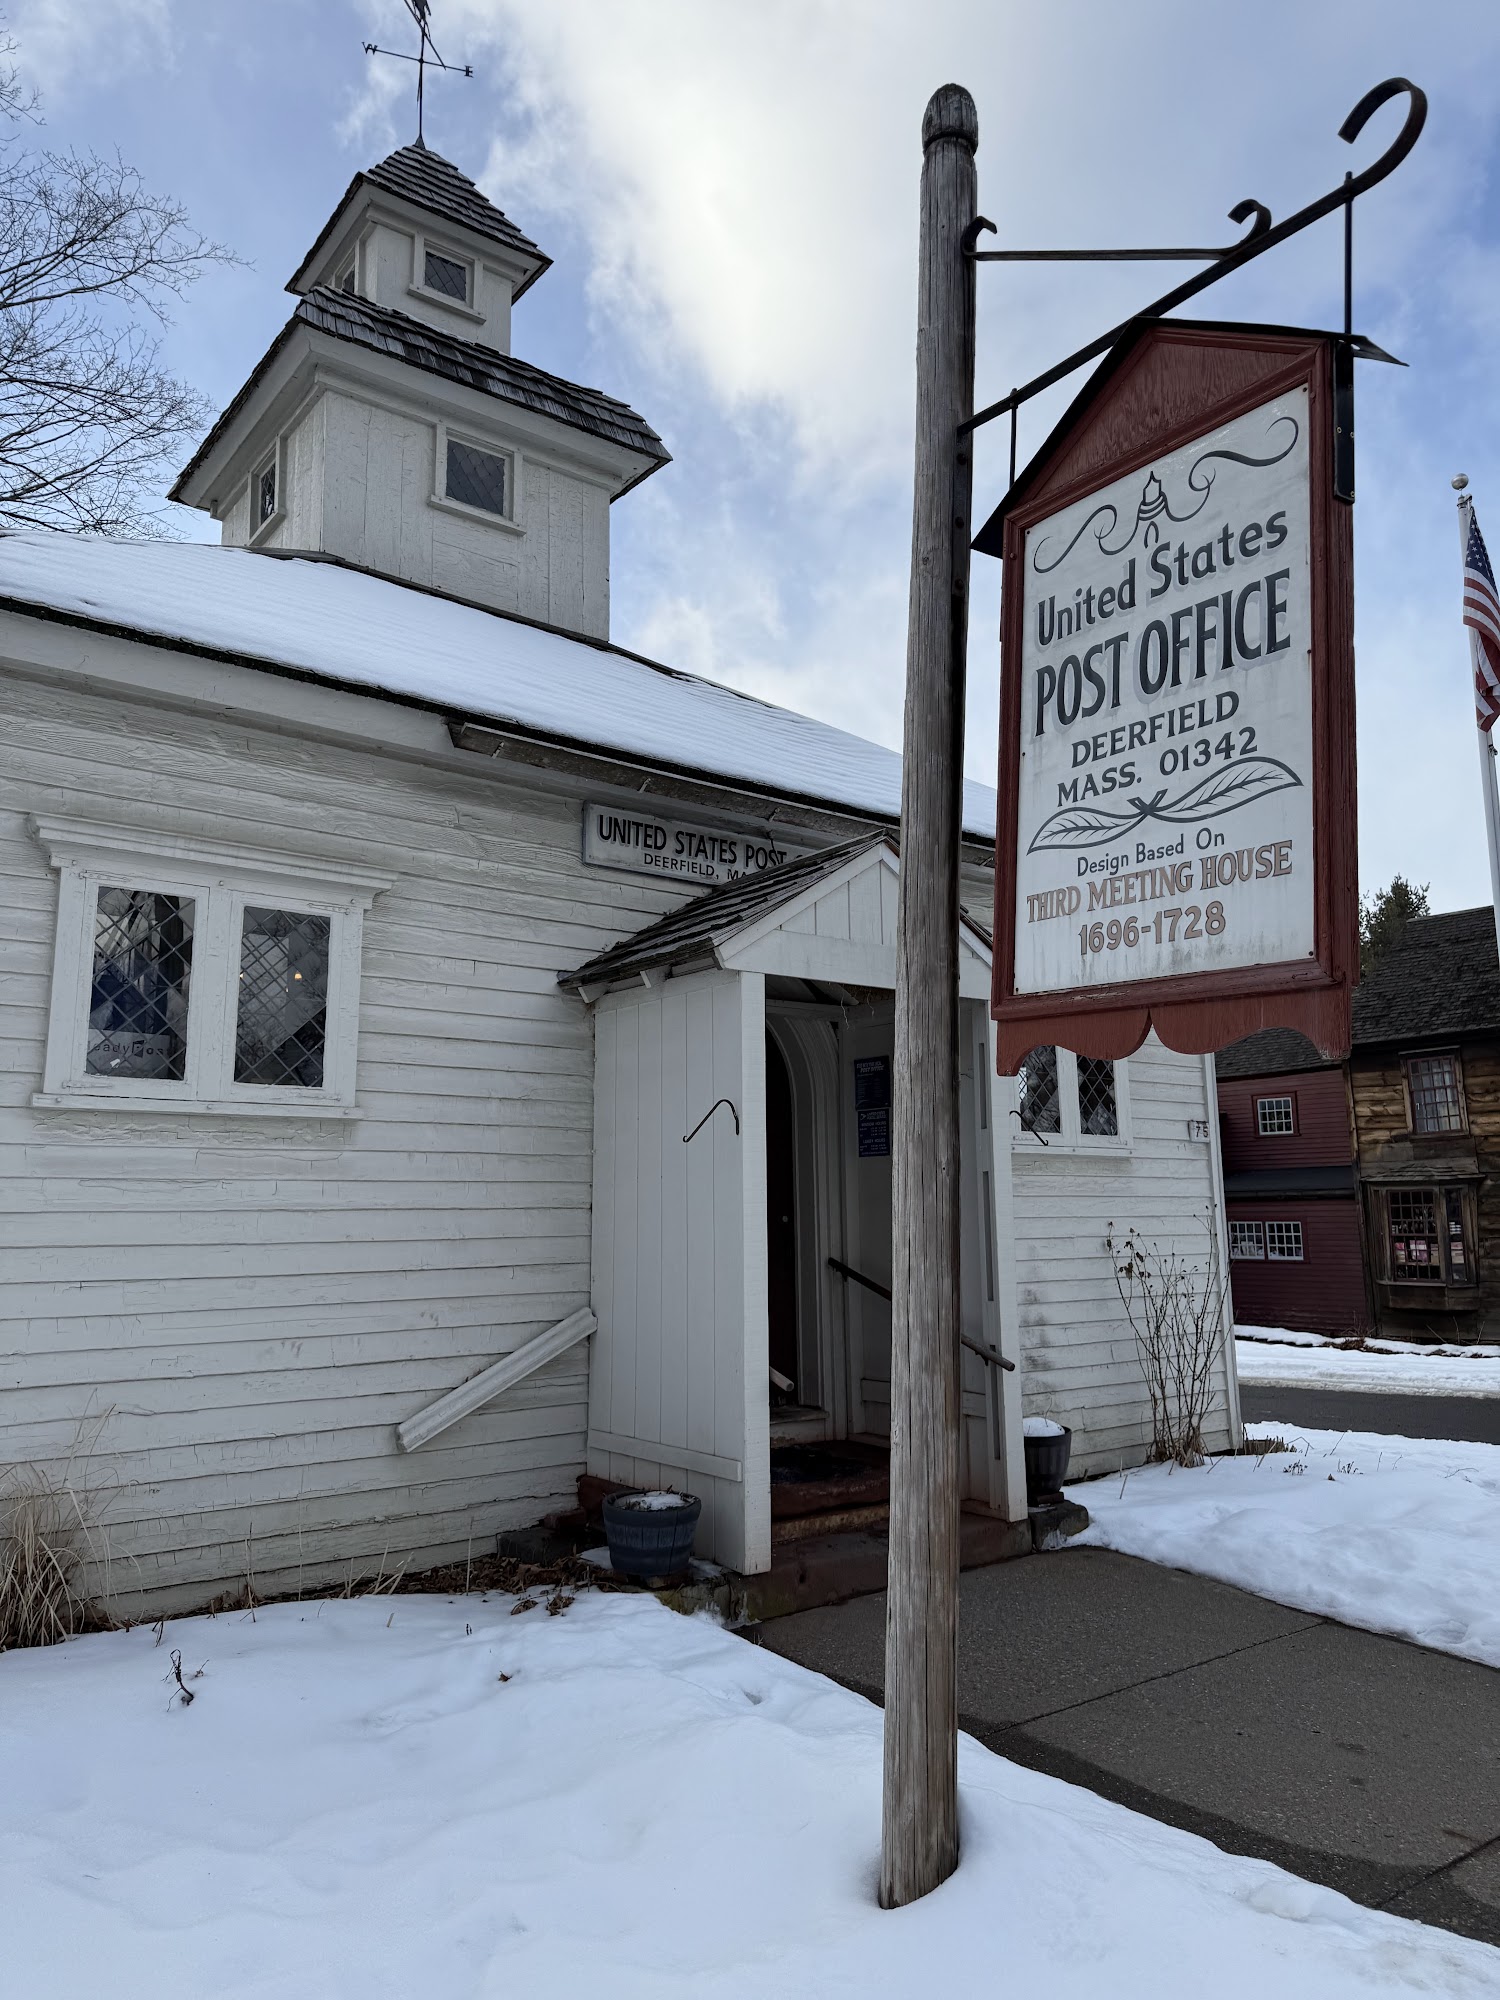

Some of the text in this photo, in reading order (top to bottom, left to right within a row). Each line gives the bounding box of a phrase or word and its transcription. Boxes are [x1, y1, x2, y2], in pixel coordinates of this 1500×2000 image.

[1037, 511, 1289, 647] United States
[1034, 567, 1291, 738] POST OFFICE
[1071, 690, 1240, 769] DEERFIELD
[1056, 726, 1258, 807] MASS. 01342
[599, 814, 787, 870] UNITED STATES POST
[644, 853, 719, 880] DEERFIELD,
[1077, 827, 1225, 877] Design Based On
[1026, 840, 1293, 923] THIRD MEETING HOUSE
[1078, 901, 1226, 955] 1696-1728
[1195, 1125, 1209, 1138] 75
